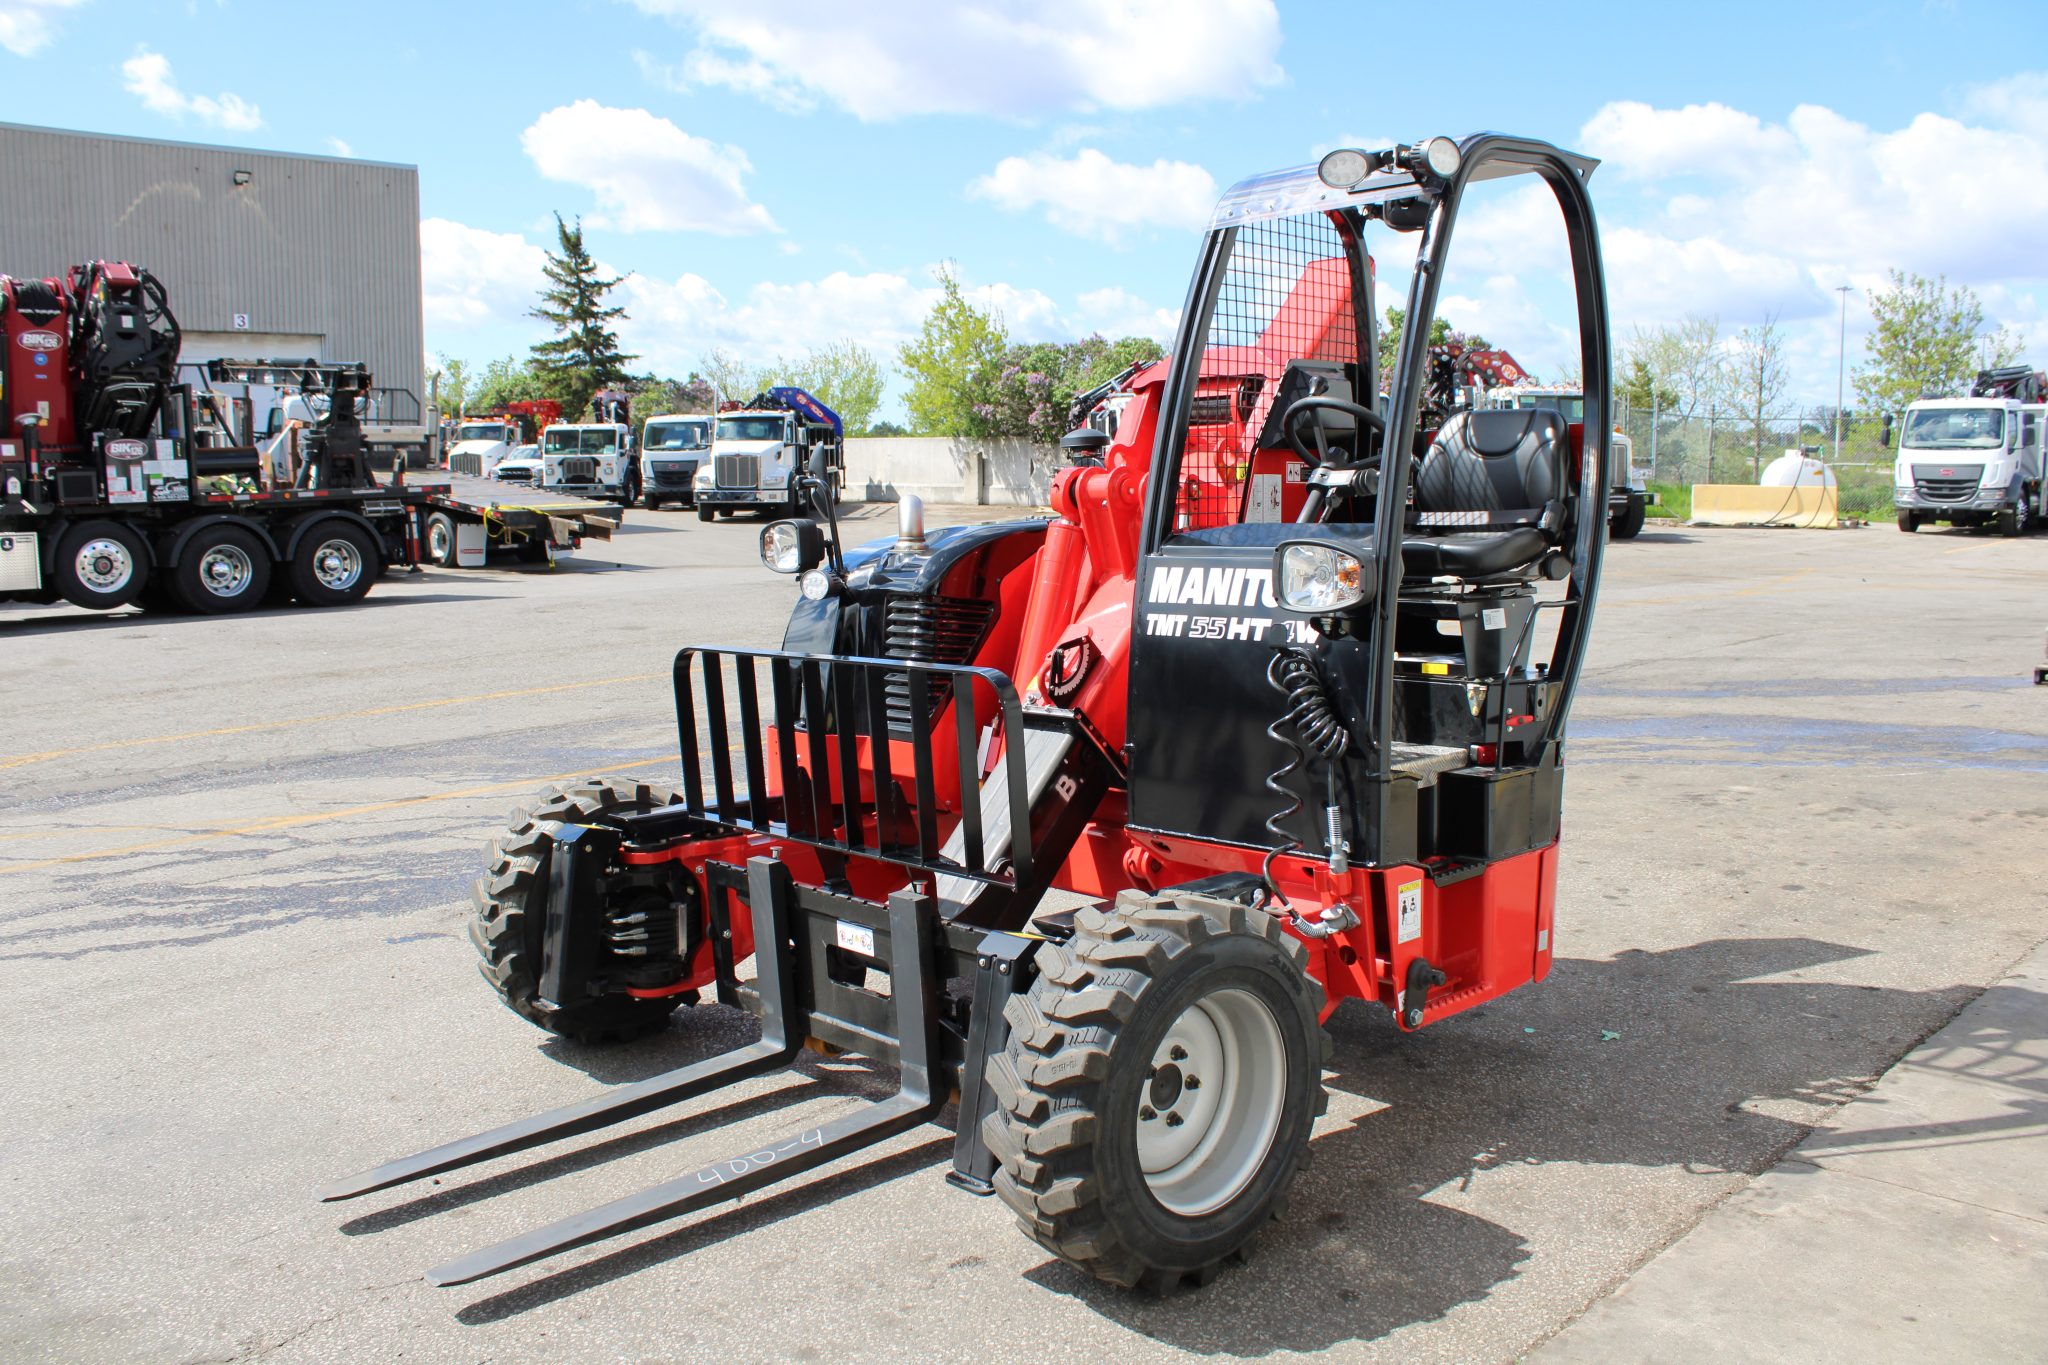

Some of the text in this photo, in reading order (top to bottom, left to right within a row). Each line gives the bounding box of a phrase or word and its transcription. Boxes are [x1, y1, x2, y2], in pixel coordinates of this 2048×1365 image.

[237, 315, 246, 328] 3
[1146, 613, 1188, 637] TMT
[698, 1129, 823, 1183] 400-4
